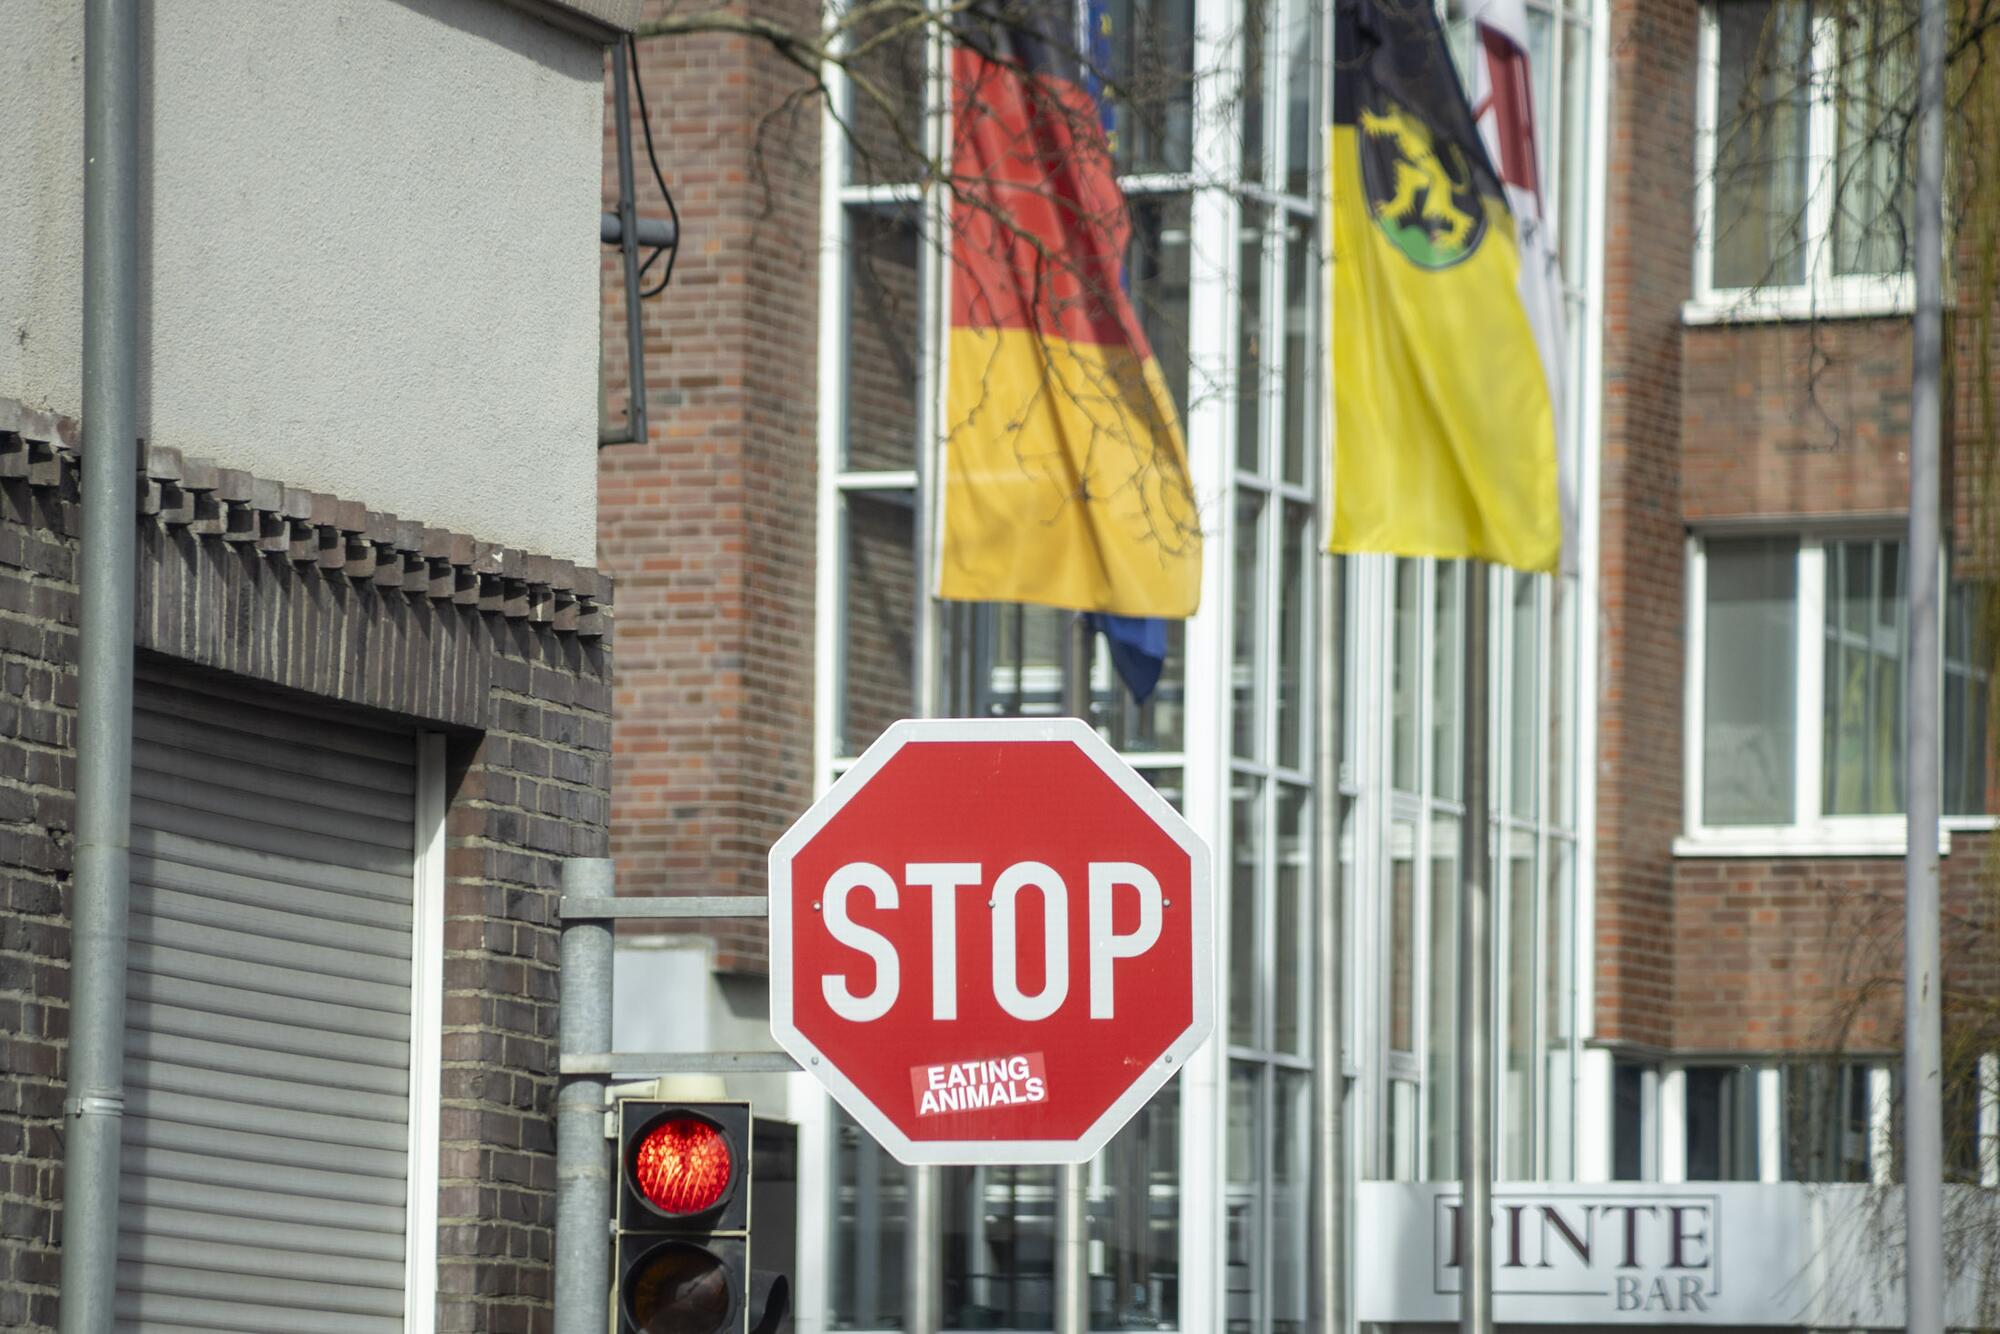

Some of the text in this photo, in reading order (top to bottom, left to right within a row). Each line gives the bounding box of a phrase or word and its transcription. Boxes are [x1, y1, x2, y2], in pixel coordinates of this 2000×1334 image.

[821, 861, 1163, 1022] STOP
[927, 1056, 1030, 1090] EATING
[919, 1077, 1045, 1115] ANIMALS
[1614, 1276, 1710, 1312] BAR
